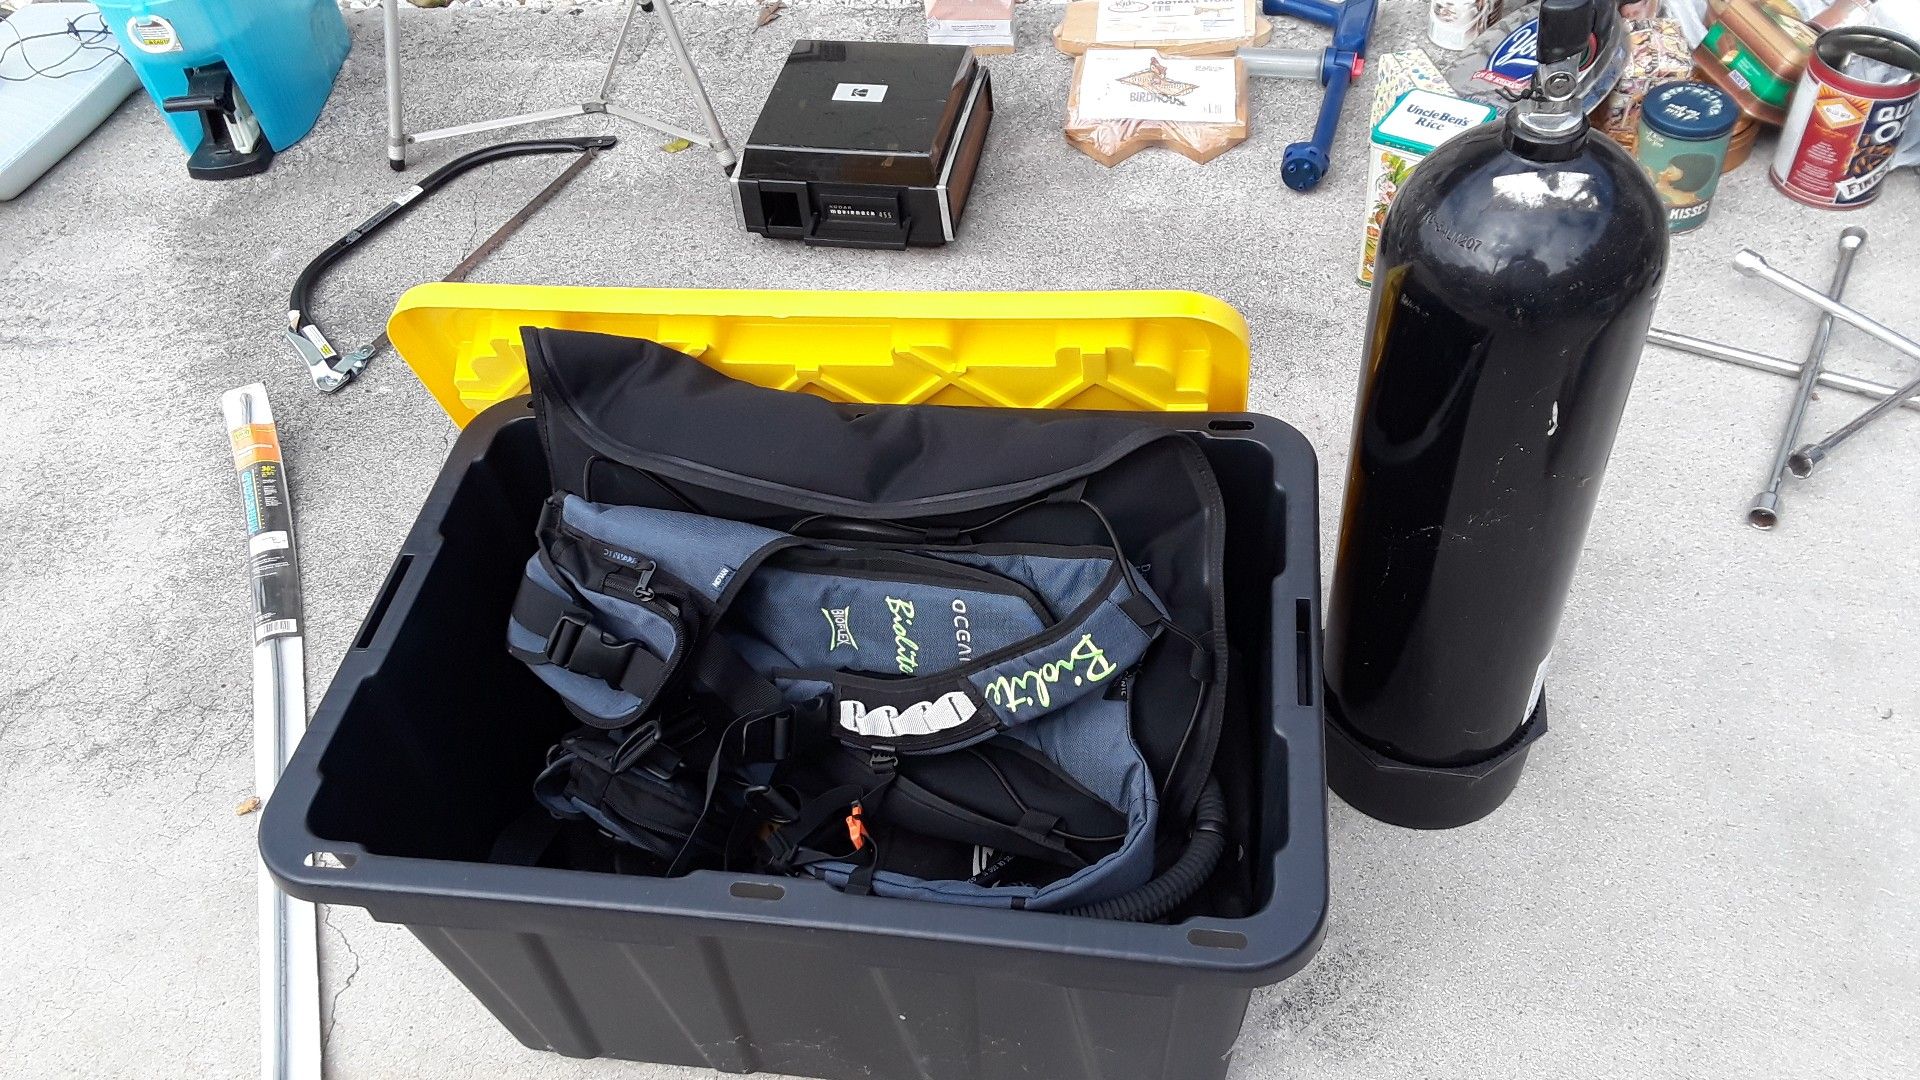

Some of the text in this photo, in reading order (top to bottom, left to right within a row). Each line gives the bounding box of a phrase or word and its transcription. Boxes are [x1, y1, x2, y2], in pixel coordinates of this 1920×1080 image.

[1406, 104, 1471, 127] Uncle Ben's
[1415, 117, 1445, 131] Rice
[1669, 200, 1709, 220] KISSES
[830, 608, 852, 645] BIOFLEX
[885, 596, 919, 674] Biolite
[984, 633, 1117, 712] Biolite
